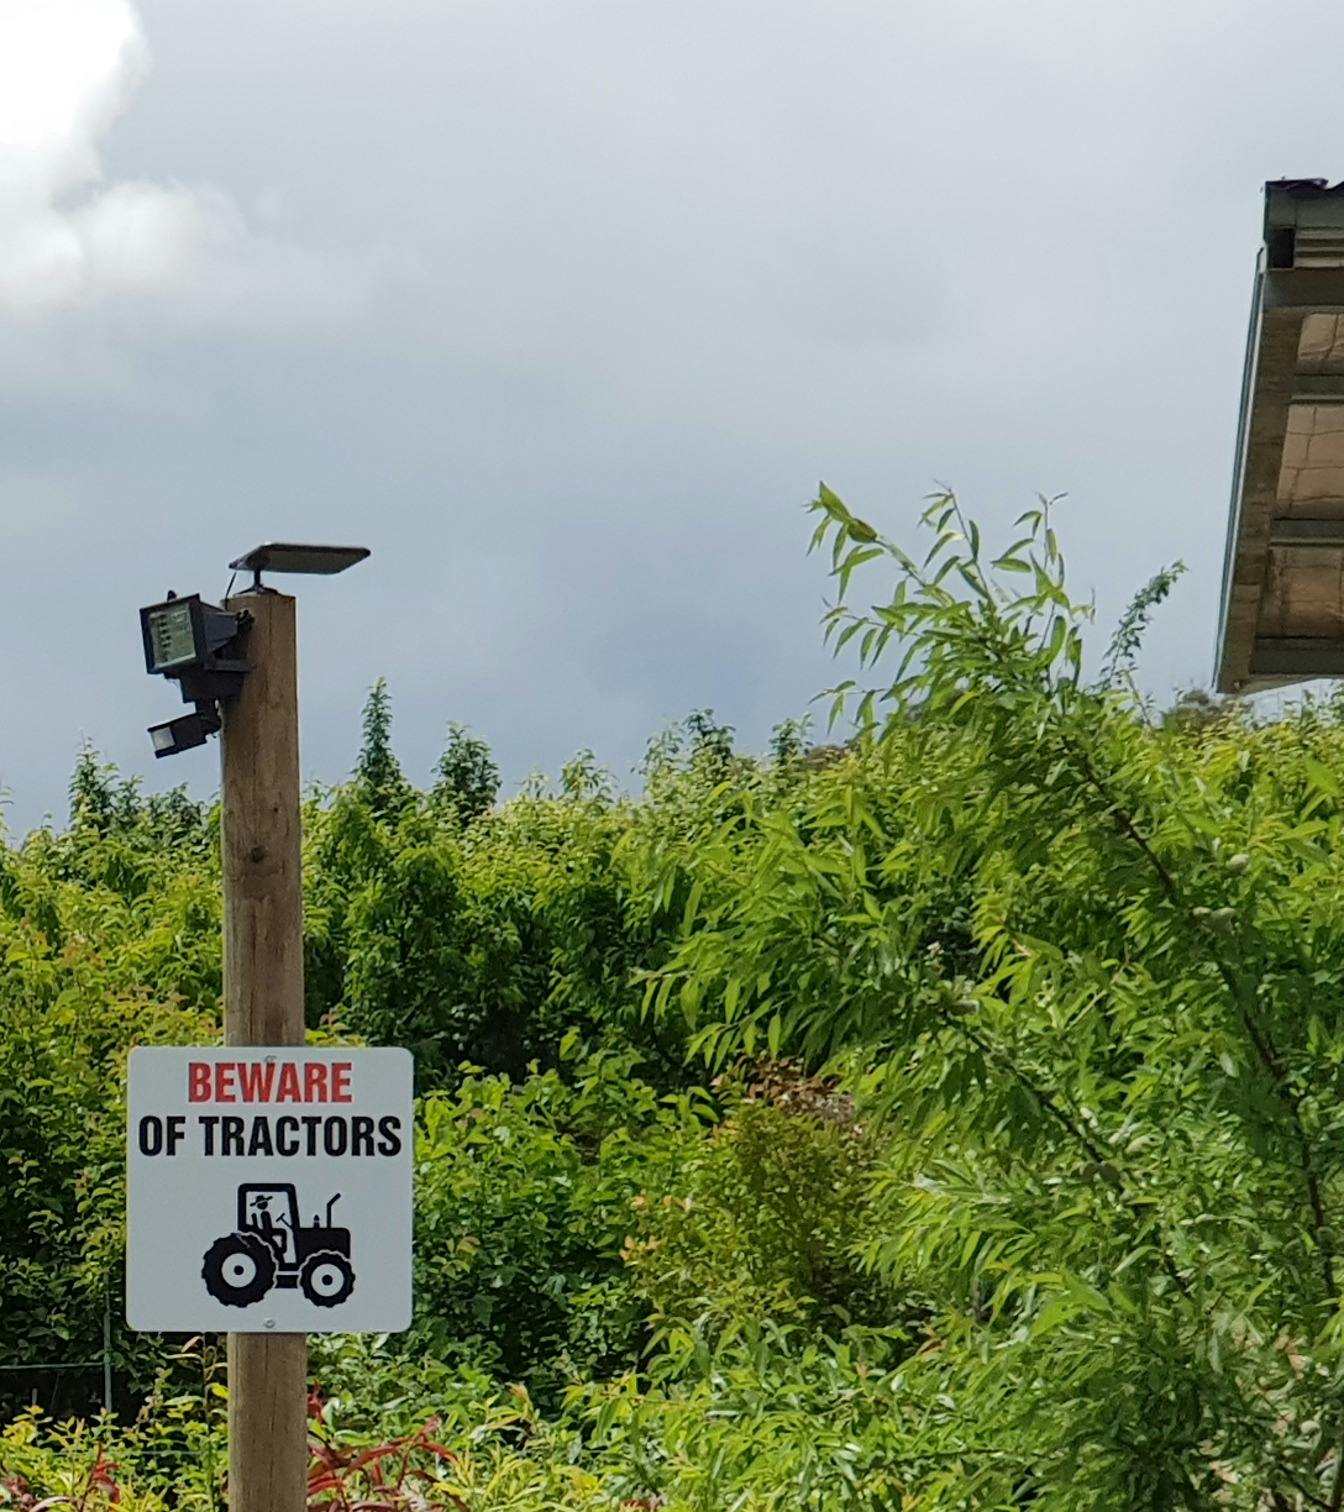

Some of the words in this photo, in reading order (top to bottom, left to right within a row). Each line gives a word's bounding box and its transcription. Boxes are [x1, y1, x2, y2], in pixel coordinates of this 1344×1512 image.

[188, 1062, 352, 1103] BEWARE
[139, 1116, 186, 1156] OF
[199, 1116, 402, 1156] TRACTORS
